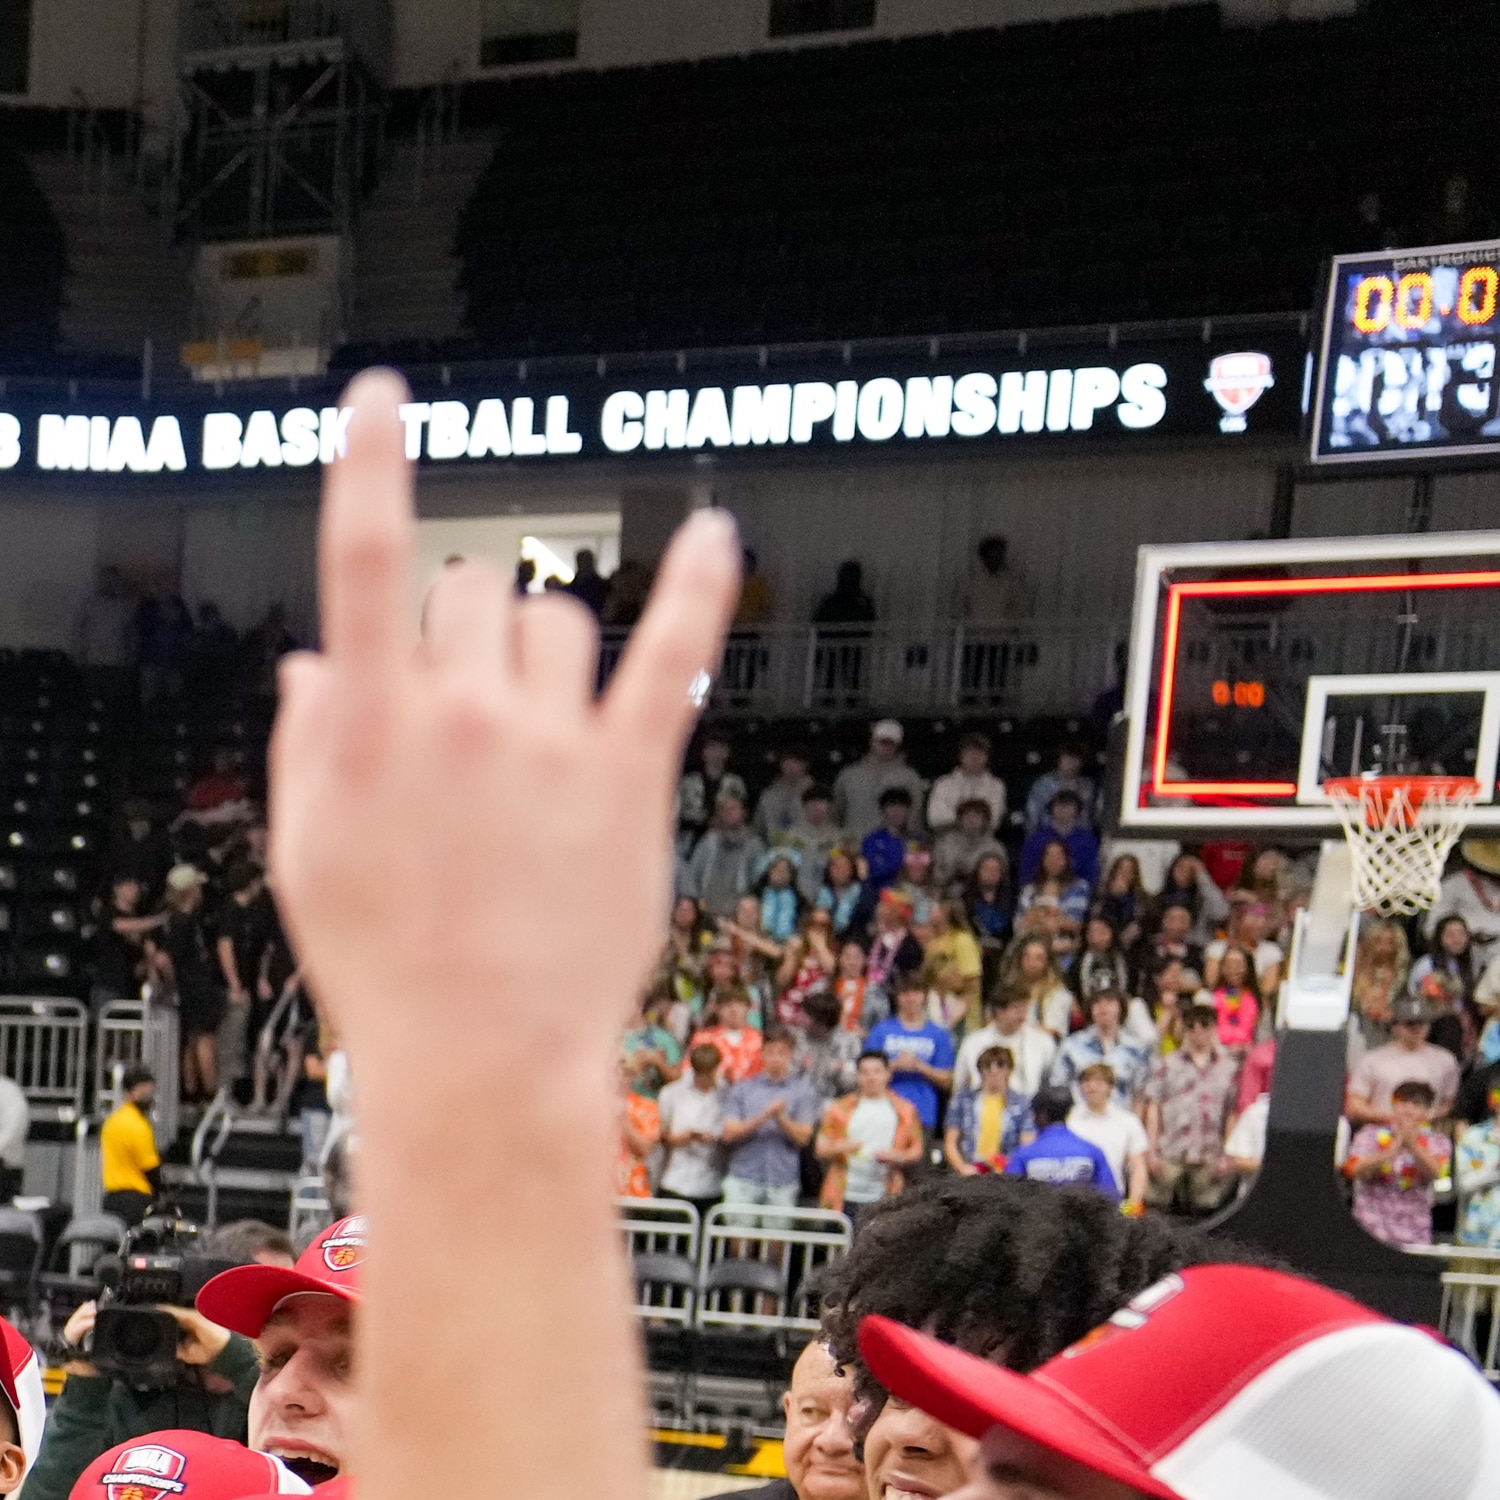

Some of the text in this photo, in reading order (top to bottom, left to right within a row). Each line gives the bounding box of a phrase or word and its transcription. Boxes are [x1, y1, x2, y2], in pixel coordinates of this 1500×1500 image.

[37, 414, 187, 472] MIAA
[202, 391, 583, 471] BASKTBALL
[601, 363, 1167, 452] CHAMPIONSHIPS
